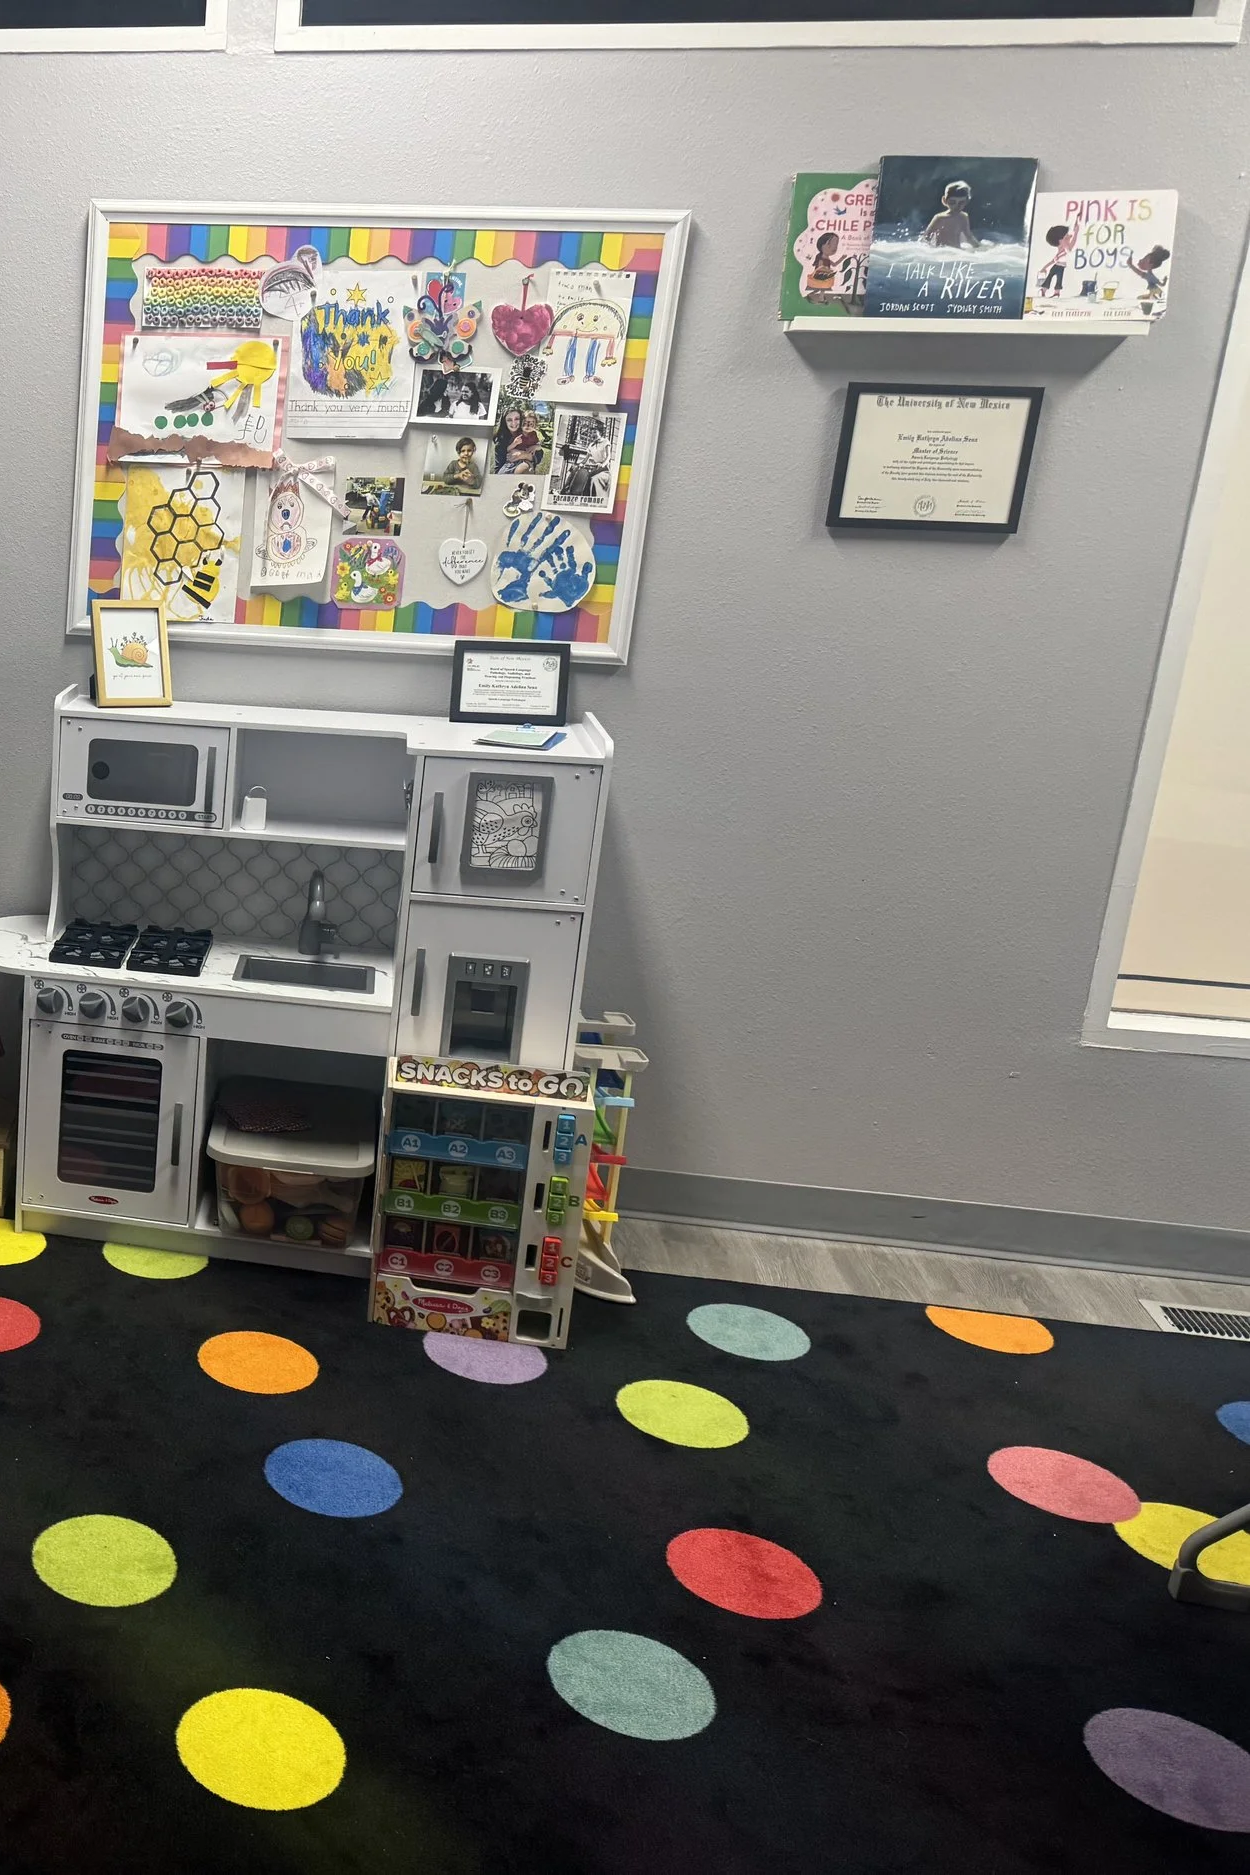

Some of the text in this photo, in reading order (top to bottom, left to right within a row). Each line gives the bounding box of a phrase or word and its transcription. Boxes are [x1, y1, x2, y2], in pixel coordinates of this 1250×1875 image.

[844, 193, 876, 206] GRE
[860, 208, 867, 217] Is
[1066, 199, 1152, 224] PINK IS
[815, 219, 859, 231] CHILE
[886, 261, 976, 281] I TALK LIKE
[917, 277, 1005, 300] A RIVER
[317, 300, 390, 326] Thank
[879, 302, 1003, 314] JORDAN SCOTT SYDNEY SMITH
[328, 350, 377, 372] You!
[525, 354, 539, 367] Bee
[289, 400, 409, 414] Thank you very much!
[876, 395, 1010, 410] The University of New Mexico
[442, 555, 484, 568] difference
[400, 1061, 585, 1098] SNACKS to GO
[562, 1121, 571, 1130] 1
[402, 1137, 420, 1149] A1
[560, 1137, 569, 1146] 2
[574, 1136, 588, 1146] A
[449, 1143, 467, 1155] A2
[496, 1149, 515, 1161] A3
[558, 1152, 567, 1161] 3
[555, 1183, 564, 1192] 1
[395, 1198, 413, 1209] B1
[553, 1198, 562, 1206] 2
[568, 1196, 580, 1206] B
[442, 1203, 460, 1215] B2
[488, 1209, 507, 1221] B3
[550, 1213, 559, 1222] 3
[548, 1244, 557, 1253] 1
[388, 1256, 406, 1267] C1
[435, 1262, 453, 1273] C2
[545, 1259, 555, 1268] 2
[561, 1257, 573, 1268] C
[481, 1269, 500, 1279] C3
[543, 1274, 553, 1283] 3
[418, 1298, 445, 1307] Melissa
[452, 1303, 469, 1312] Doug
